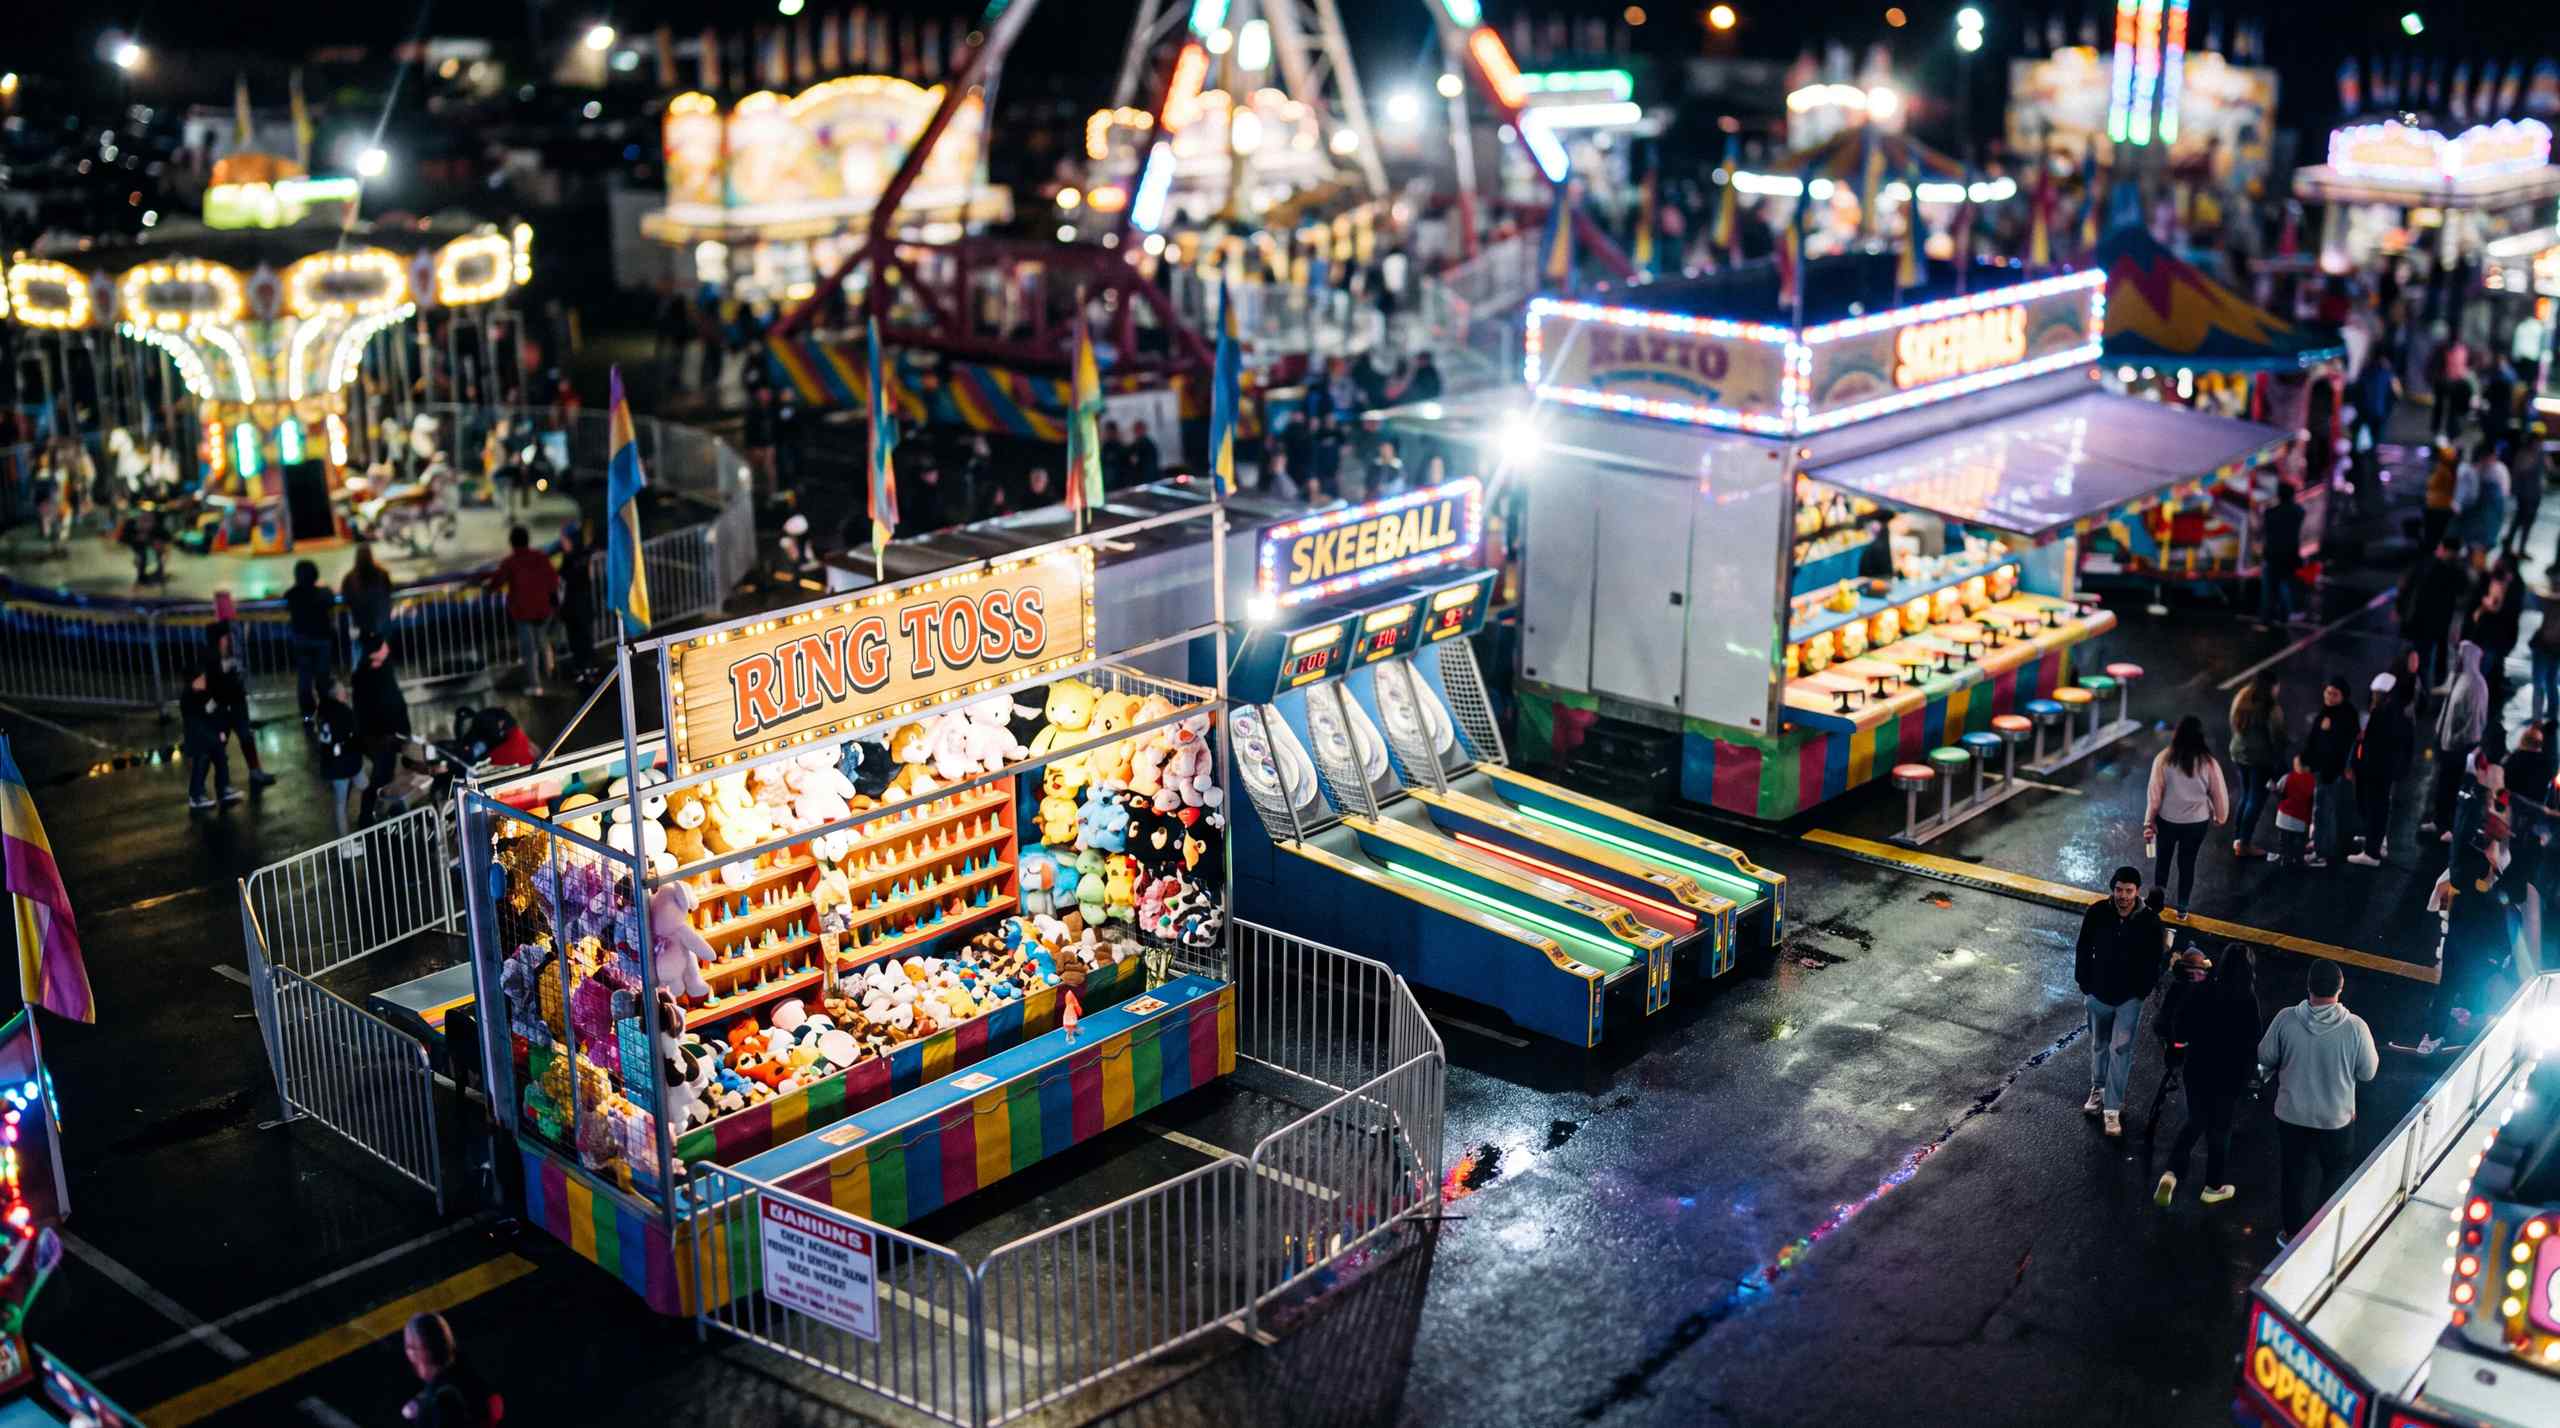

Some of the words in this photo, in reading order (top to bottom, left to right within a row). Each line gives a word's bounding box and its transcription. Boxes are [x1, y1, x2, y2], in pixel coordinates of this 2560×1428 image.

[1289, 500, 1457, 585] SKEEBALL
[729, 616, 890, 741] RING
[900, 586, 1047, 678] TOSS
